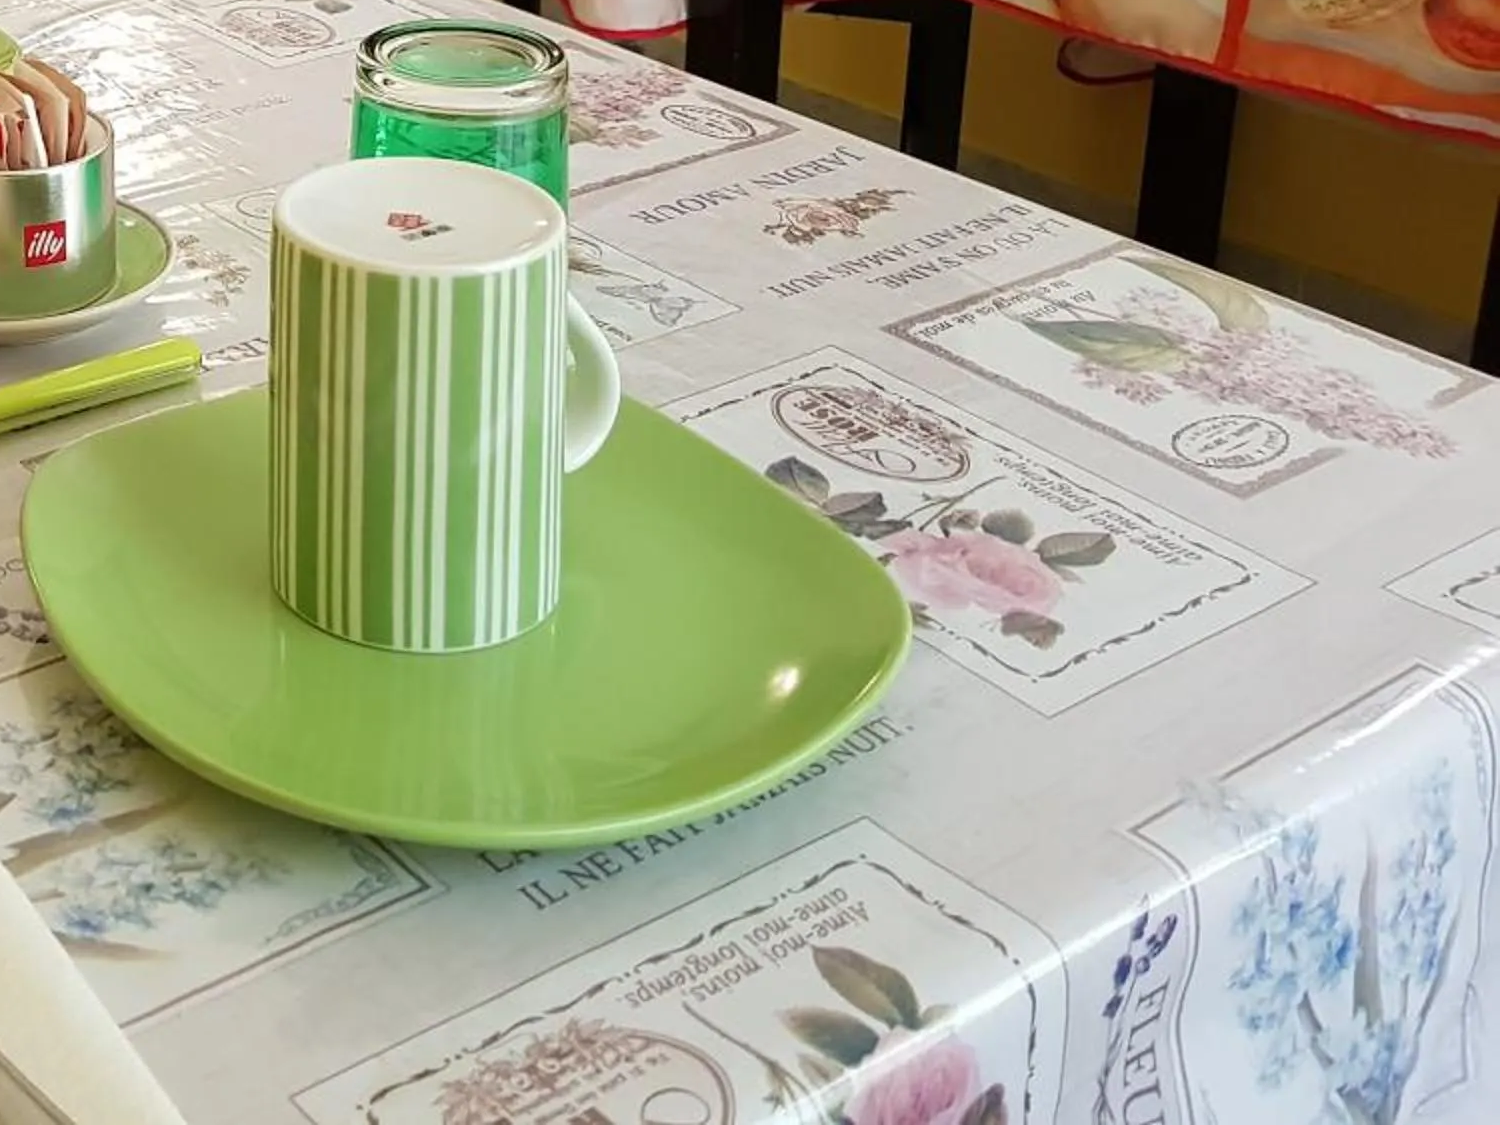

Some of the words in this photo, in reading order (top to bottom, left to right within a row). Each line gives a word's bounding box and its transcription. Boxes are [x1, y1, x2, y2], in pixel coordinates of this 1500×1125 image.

[751, 146, 866, 190] JARDIN
[629, 183, 750, 225] AMOUR
[27, 231, 64, 261] illy
[794, 398, 880, 443] ROSE
[518, 878, 569, 911] IL
[560, 853, 623, 891] NE
[826, 715, 915, 767] NUIT.
[616, 943, 744, 1010] longtemps.
